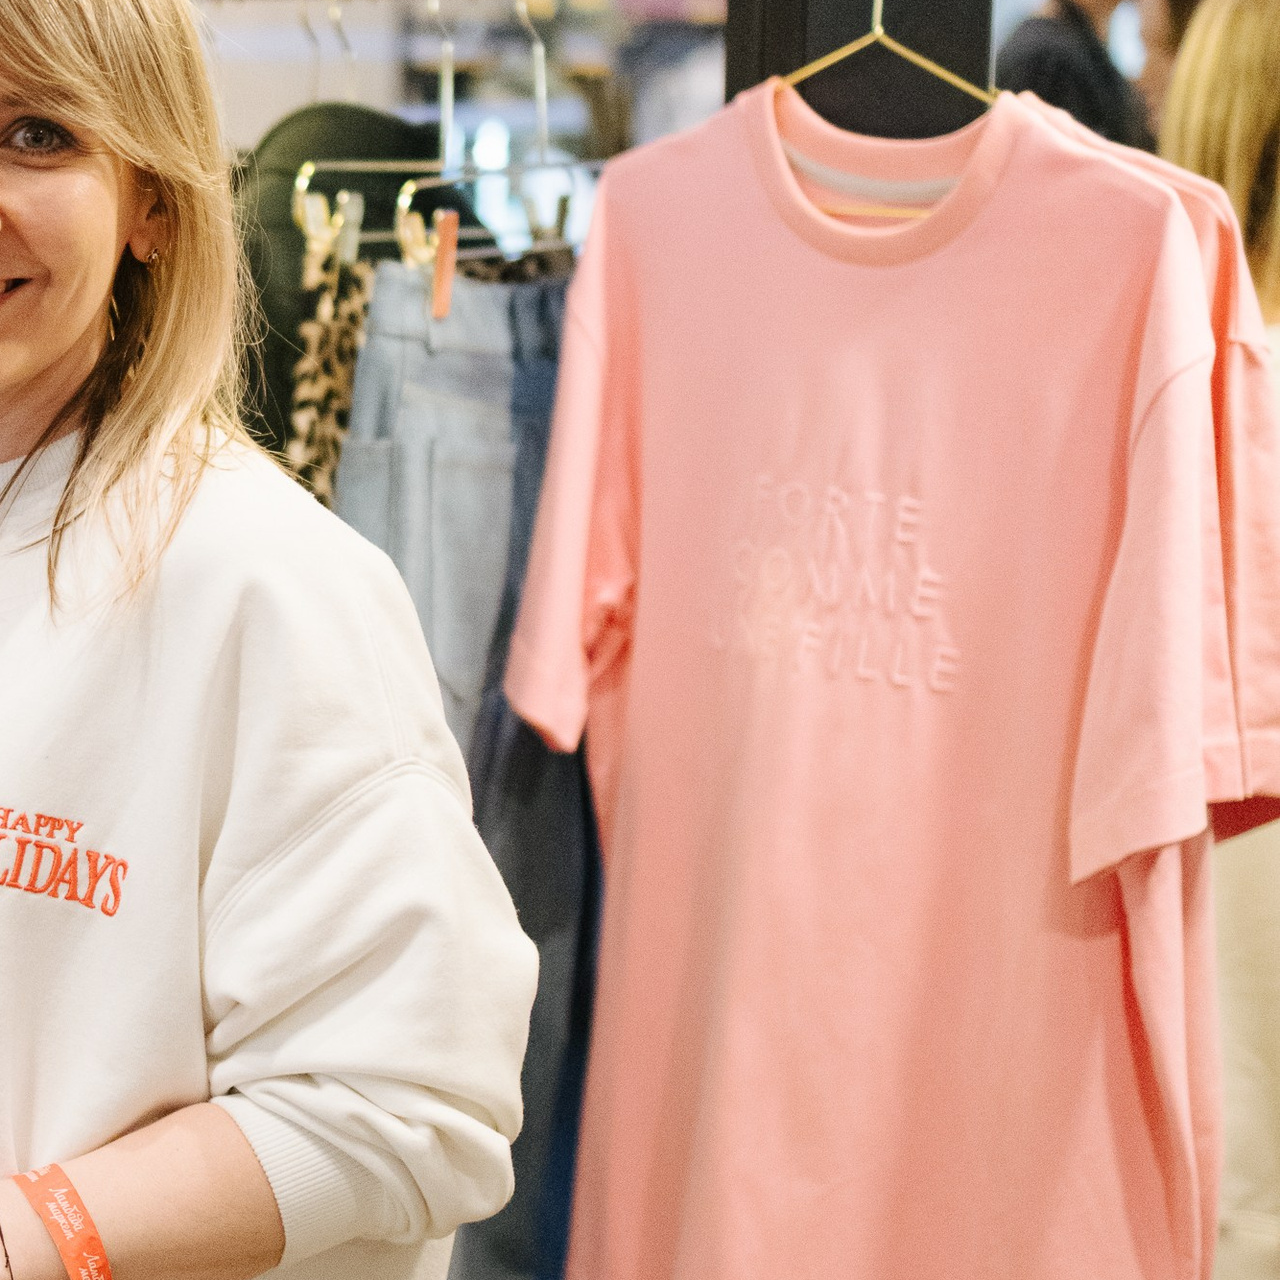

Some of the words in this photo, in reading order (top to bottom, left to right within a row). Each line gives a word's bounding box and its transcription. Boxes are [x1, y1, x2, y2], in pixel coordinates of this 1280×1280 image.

[754, 472, 923, 546] FORTE
[794, 621, 961, 697] FILLE
[46, 1201, 75, 1240] маркет
[49, 1188, 85, 1233] Ламбада
